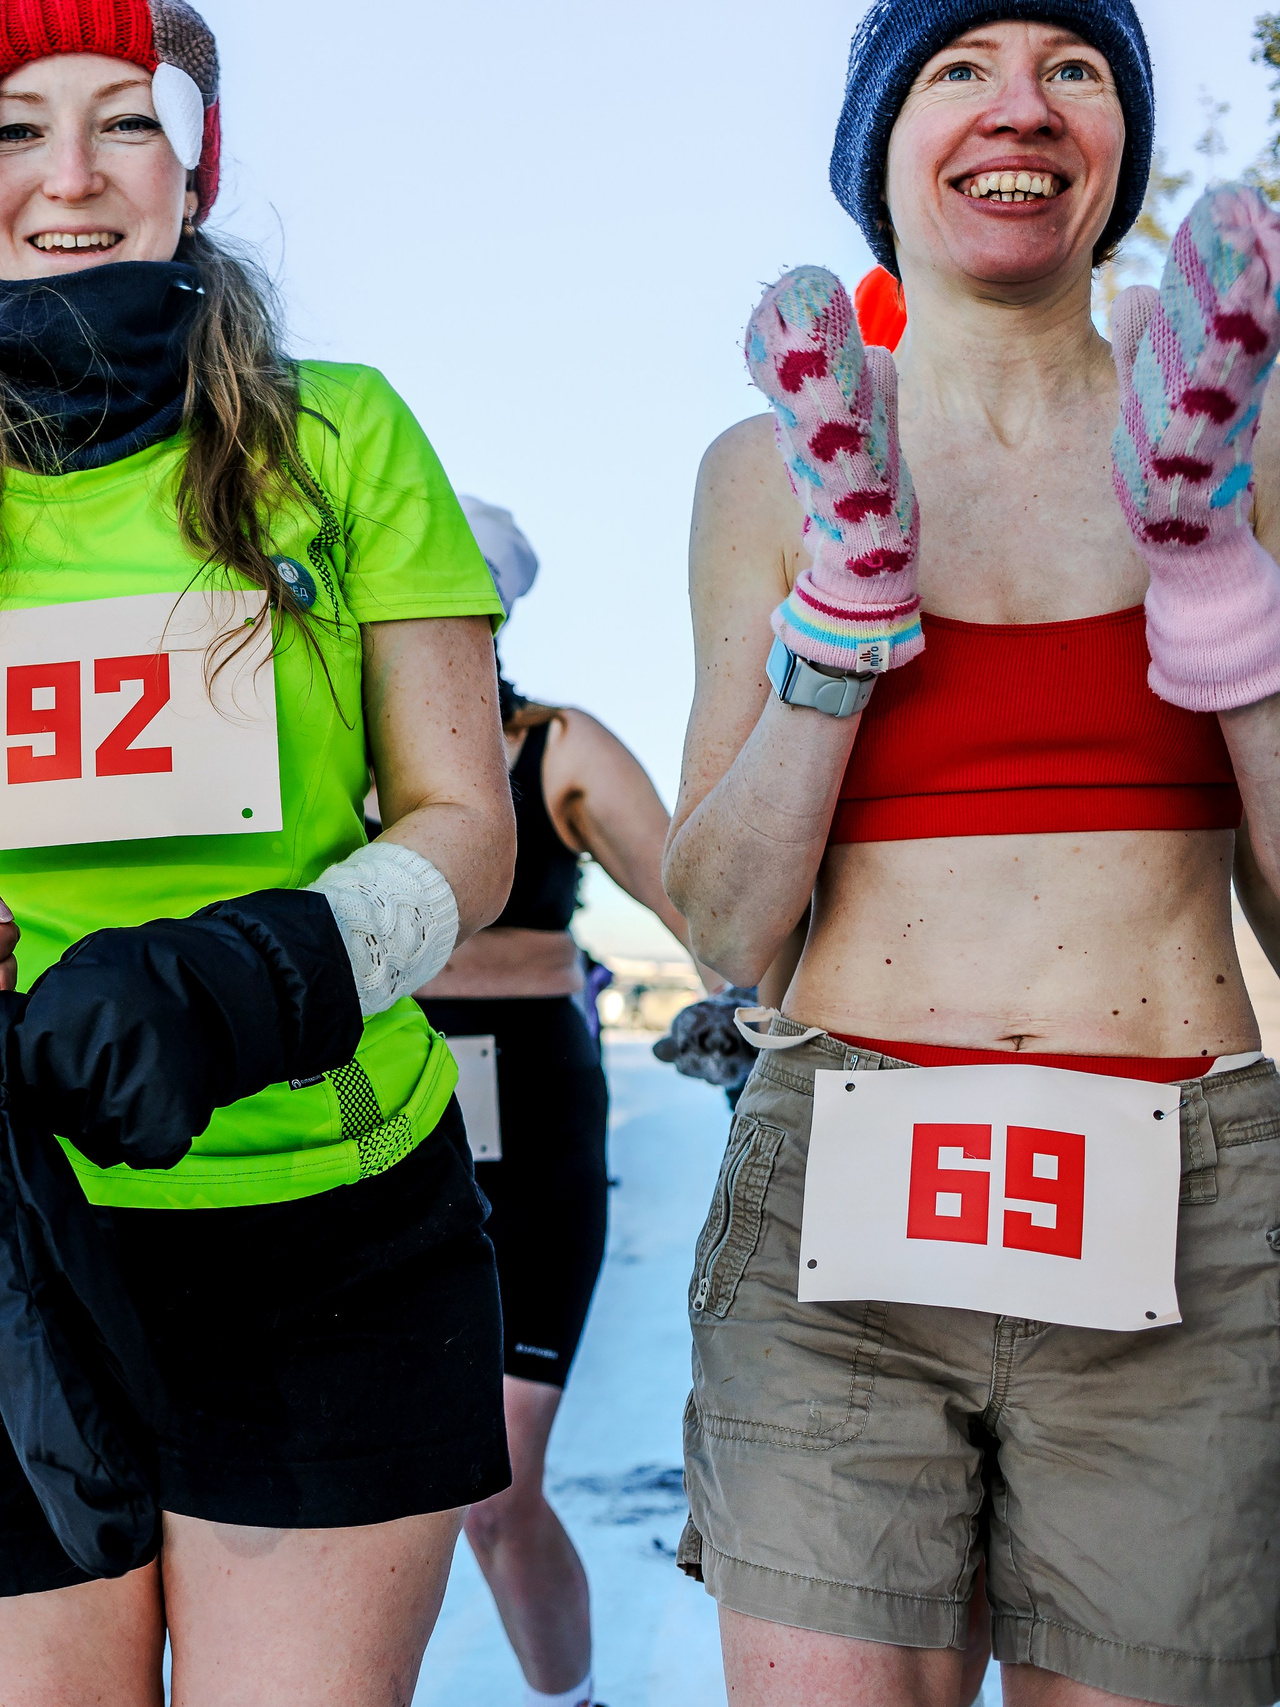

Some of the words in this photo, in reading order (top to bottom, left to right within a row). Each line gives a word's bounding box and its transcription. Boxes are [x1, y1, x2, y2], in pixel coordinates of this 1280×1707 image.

[6, 652, 172, 785] 92
[870, 645, 879, 667] miro
[906, 1123, 1086, 1260] 69
